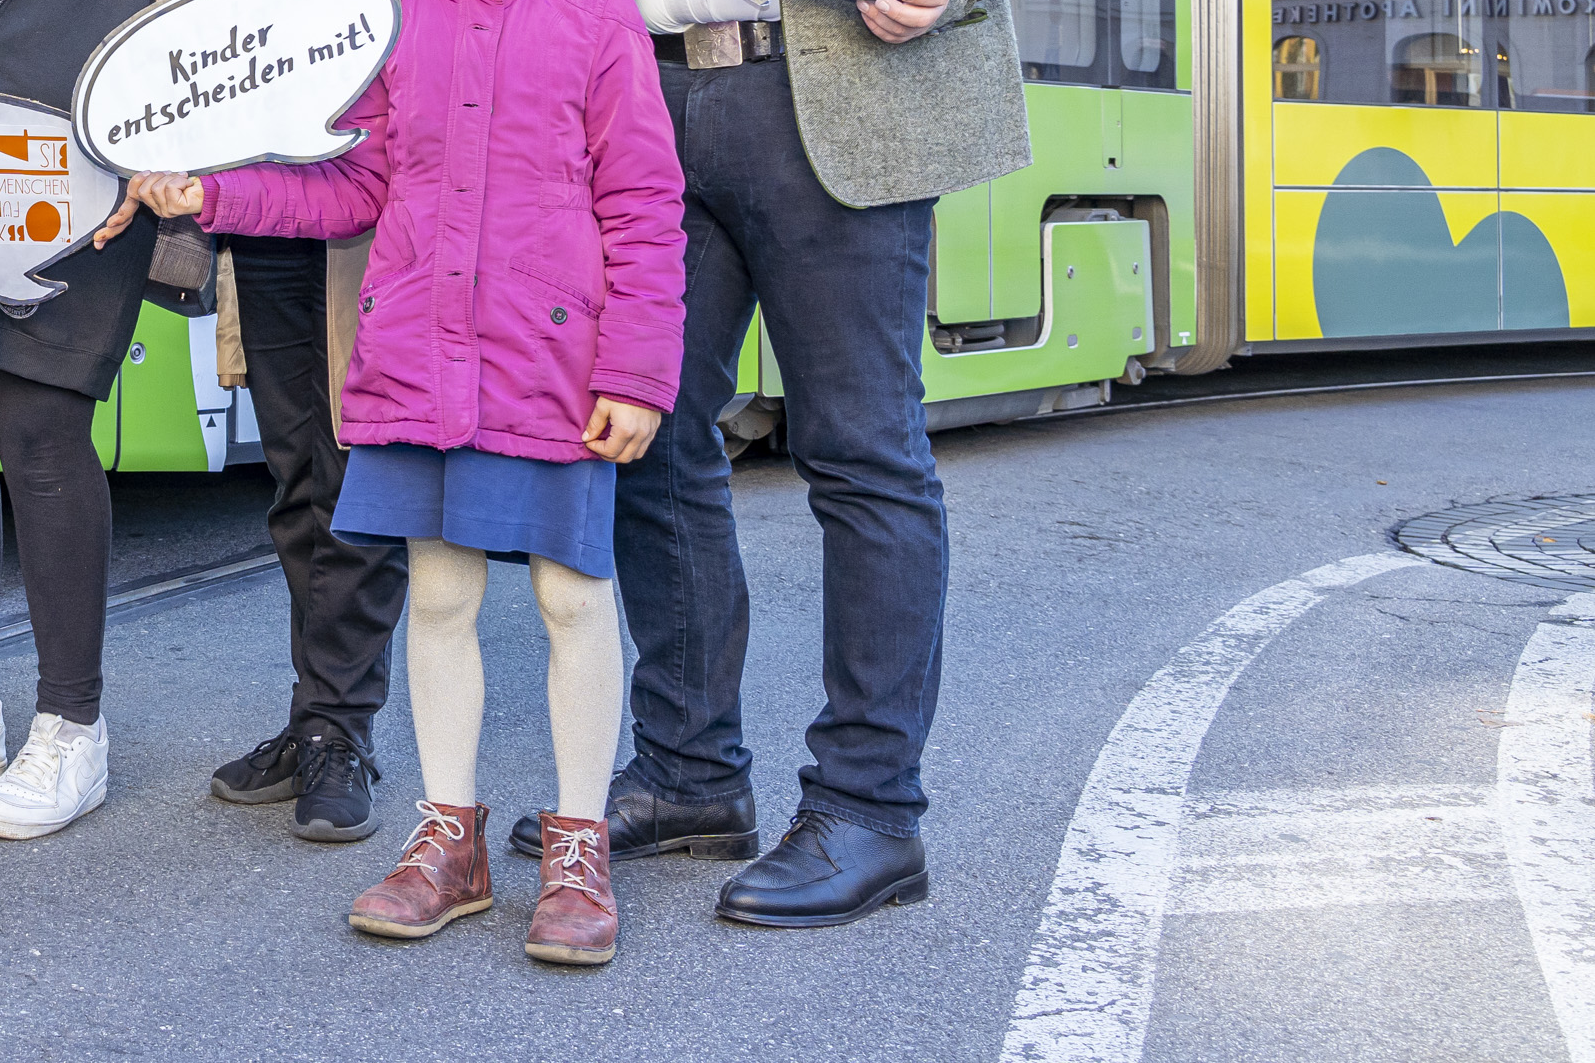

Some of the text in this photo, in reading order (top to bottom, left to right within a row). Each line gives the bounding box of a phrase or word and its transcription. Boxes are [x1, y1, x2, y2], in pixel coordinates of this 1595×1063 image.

[107, 12, 376, 145] entscheiden mit!
[168, 24, 274, 85] Kinder
